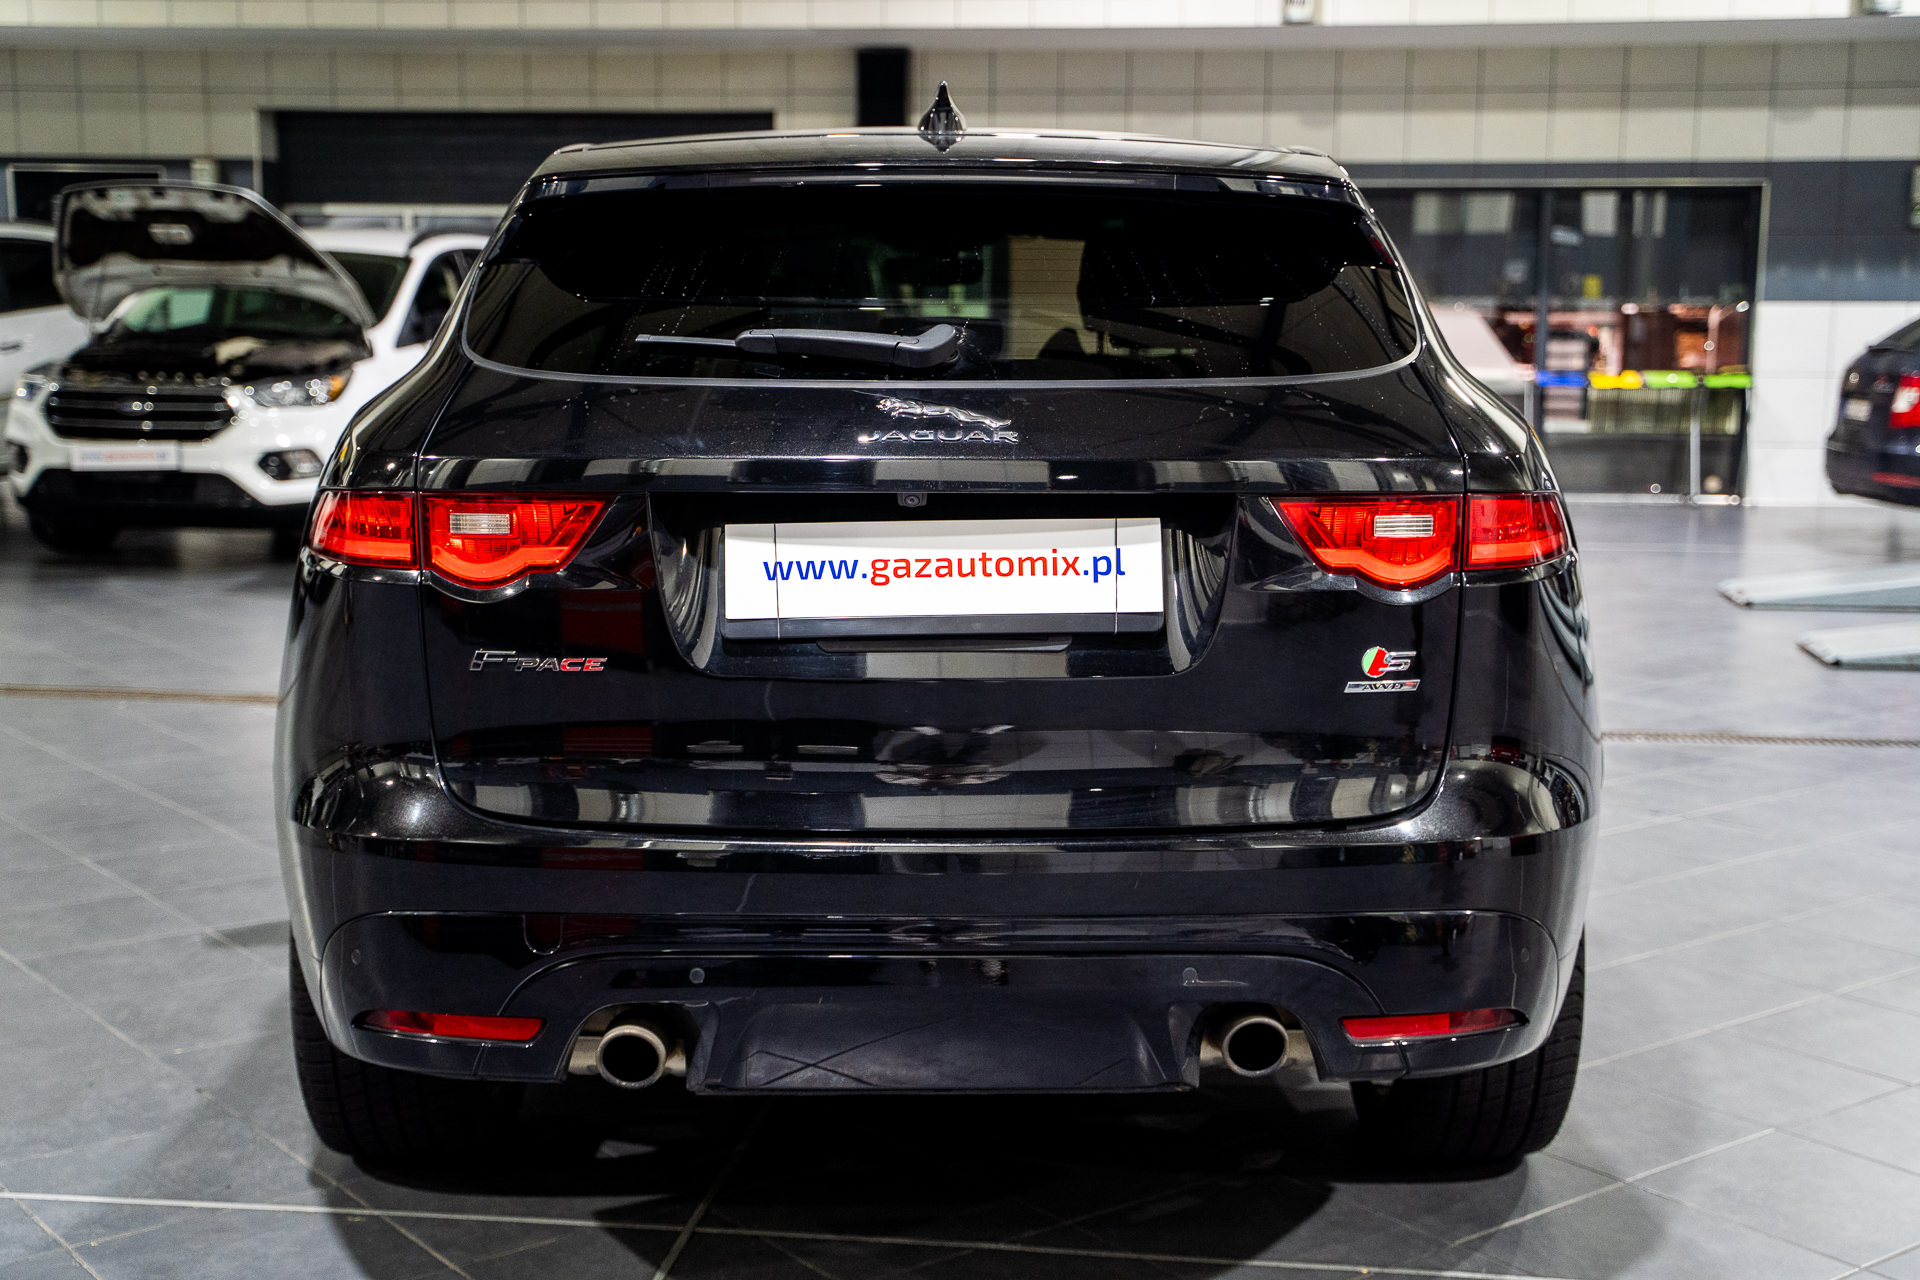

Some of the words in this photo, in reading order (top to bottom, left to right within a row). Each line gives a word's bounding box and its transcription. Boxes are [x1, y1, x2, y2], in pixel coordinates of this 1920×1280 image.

[858, 430, 1019, 444] JAGUAR
[763, 548, 1126, 586] www.gazautomix.pl
[1378, 651, 1417, 672] S
